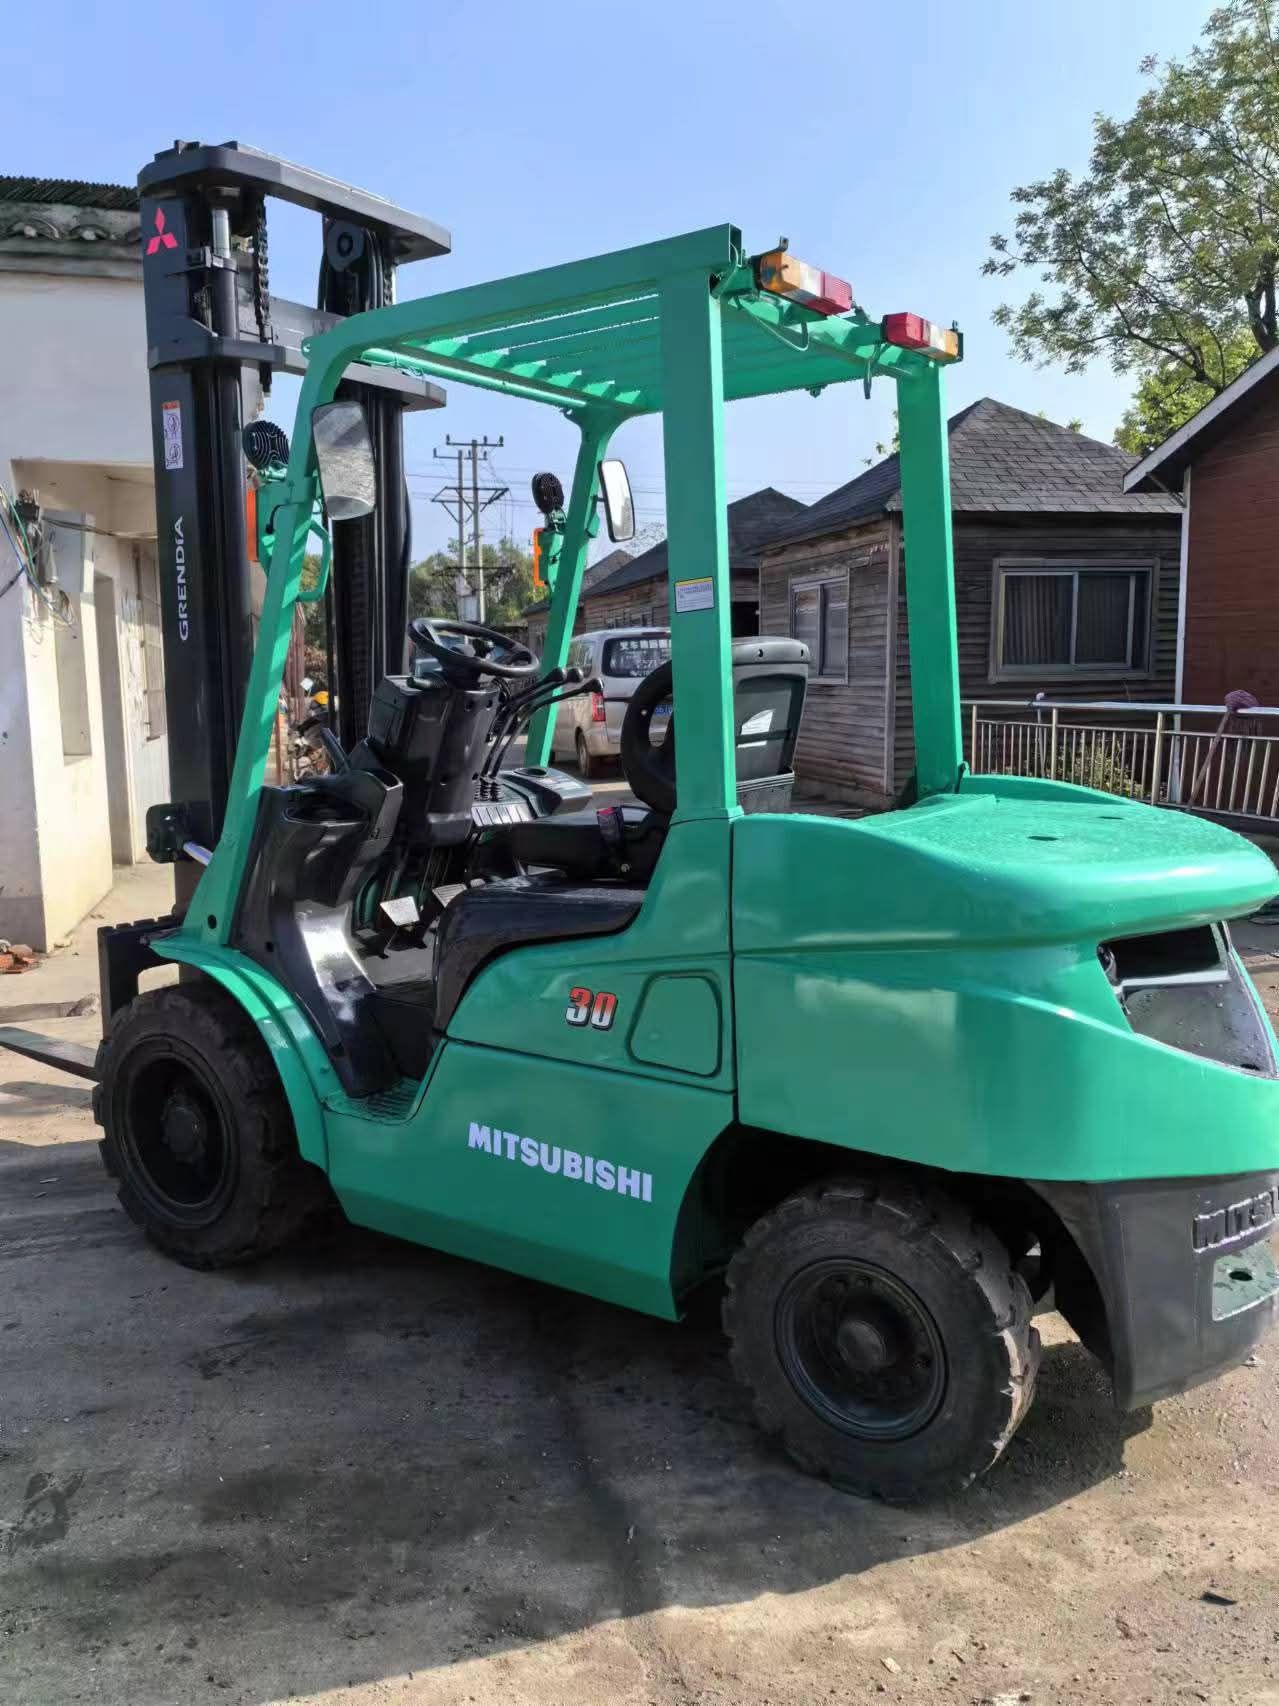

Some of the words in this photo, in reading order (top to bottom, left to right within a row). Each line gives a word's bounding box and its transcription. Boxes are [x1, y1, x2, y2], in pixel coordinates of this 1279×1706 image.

[174, 516, 189, 641] GRENDIA
[565, 986, 618, 1031] 30
[468, 1121, 652, 1202] MITSUBISHI
